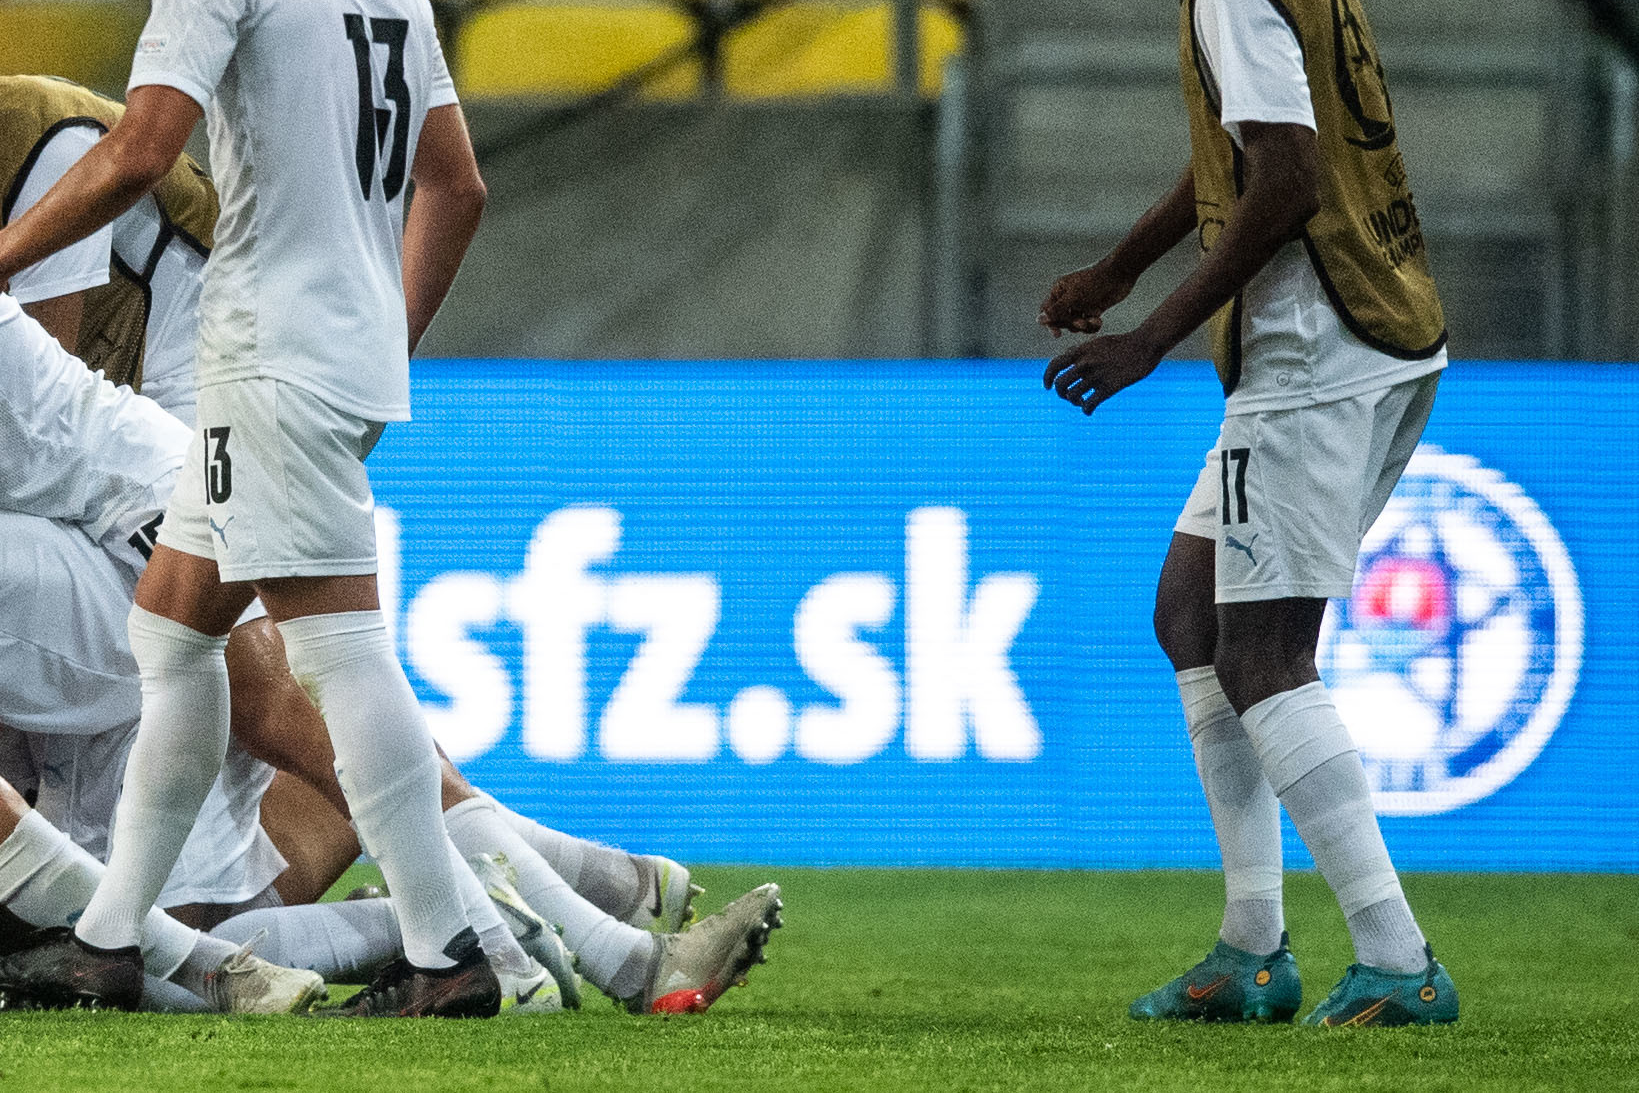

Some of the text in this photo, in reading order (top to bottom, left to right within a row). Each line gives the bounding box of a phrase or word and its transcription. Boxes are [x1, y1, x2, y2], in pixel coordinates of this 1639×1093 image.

[344, 13, 411, 203] 13
[204, 426, 232, 505] 13
[1221, 447, 1251, 526] 17
